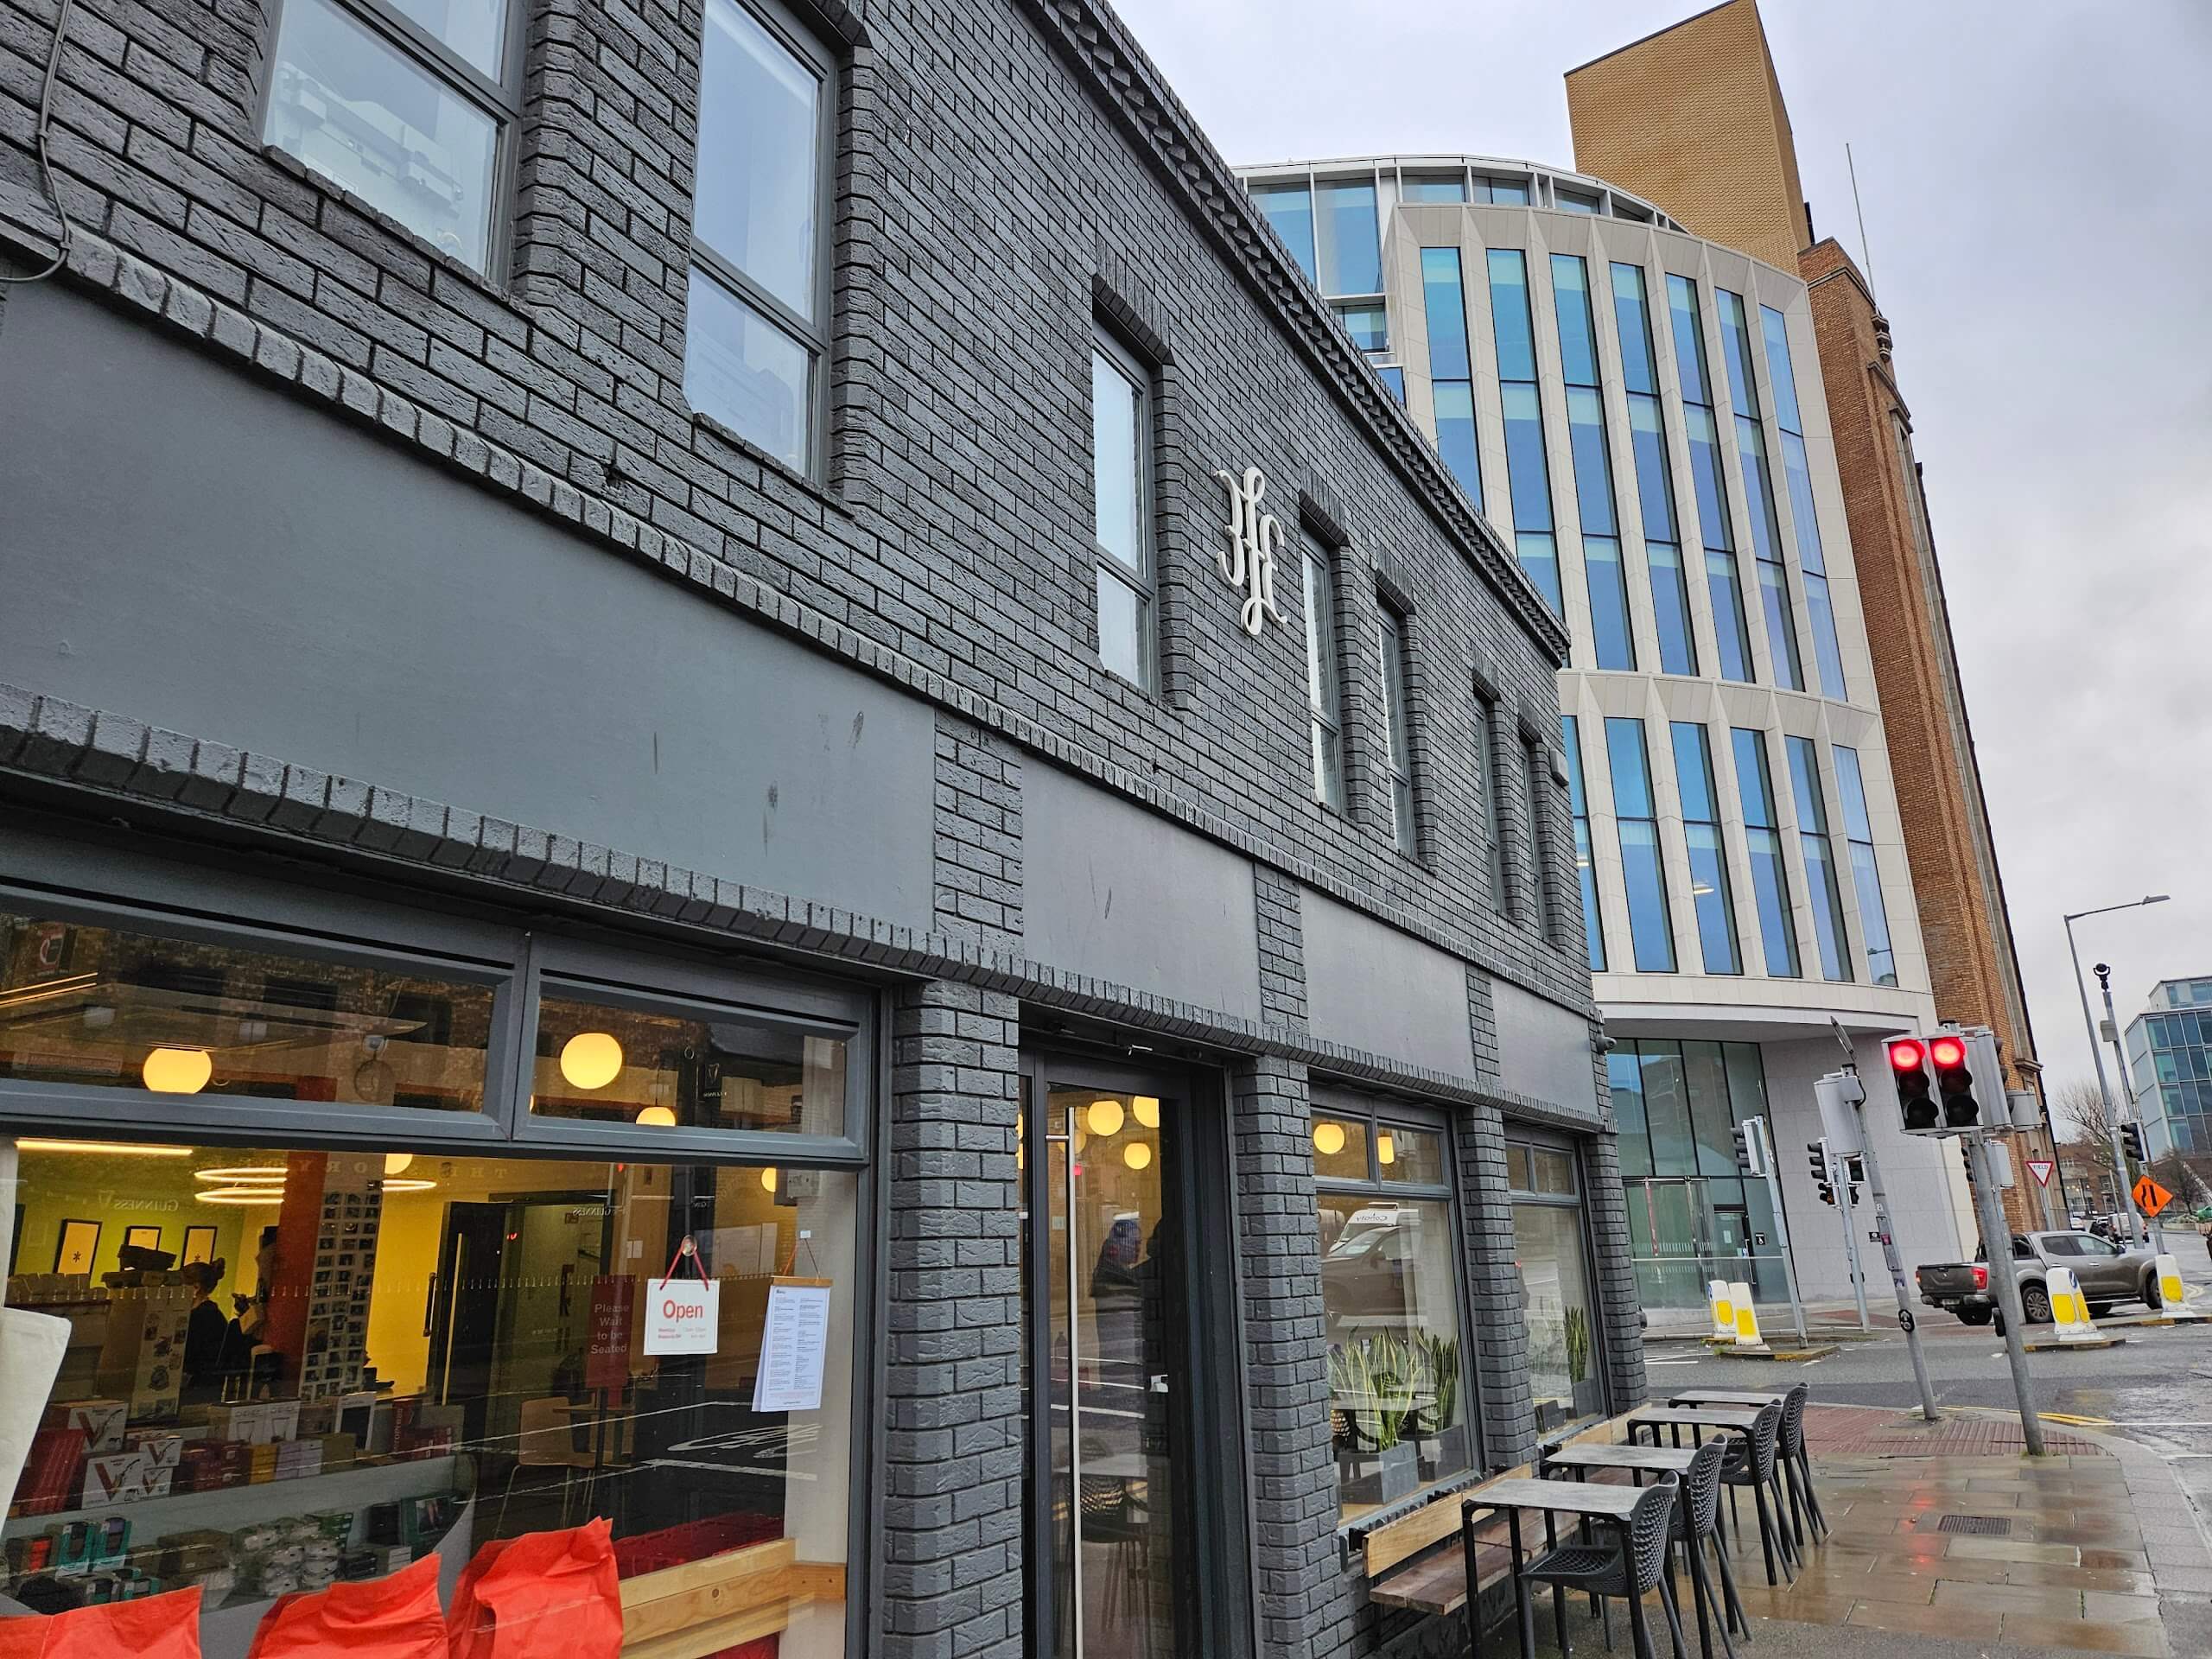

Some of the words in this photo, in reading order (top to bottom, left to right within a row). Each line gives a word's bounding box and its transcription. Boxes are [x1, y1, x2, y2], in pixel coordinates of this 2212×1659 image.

[594, 1303, 630, 1313] Please
[663, 1300, 703, 1323] Open
[599, 1315, 623, 1326] Wait
[597, 1331, 607, 1340] to
[610, 1330, 623, 1340] be
[590, 1343, 628, 1354] Seated
